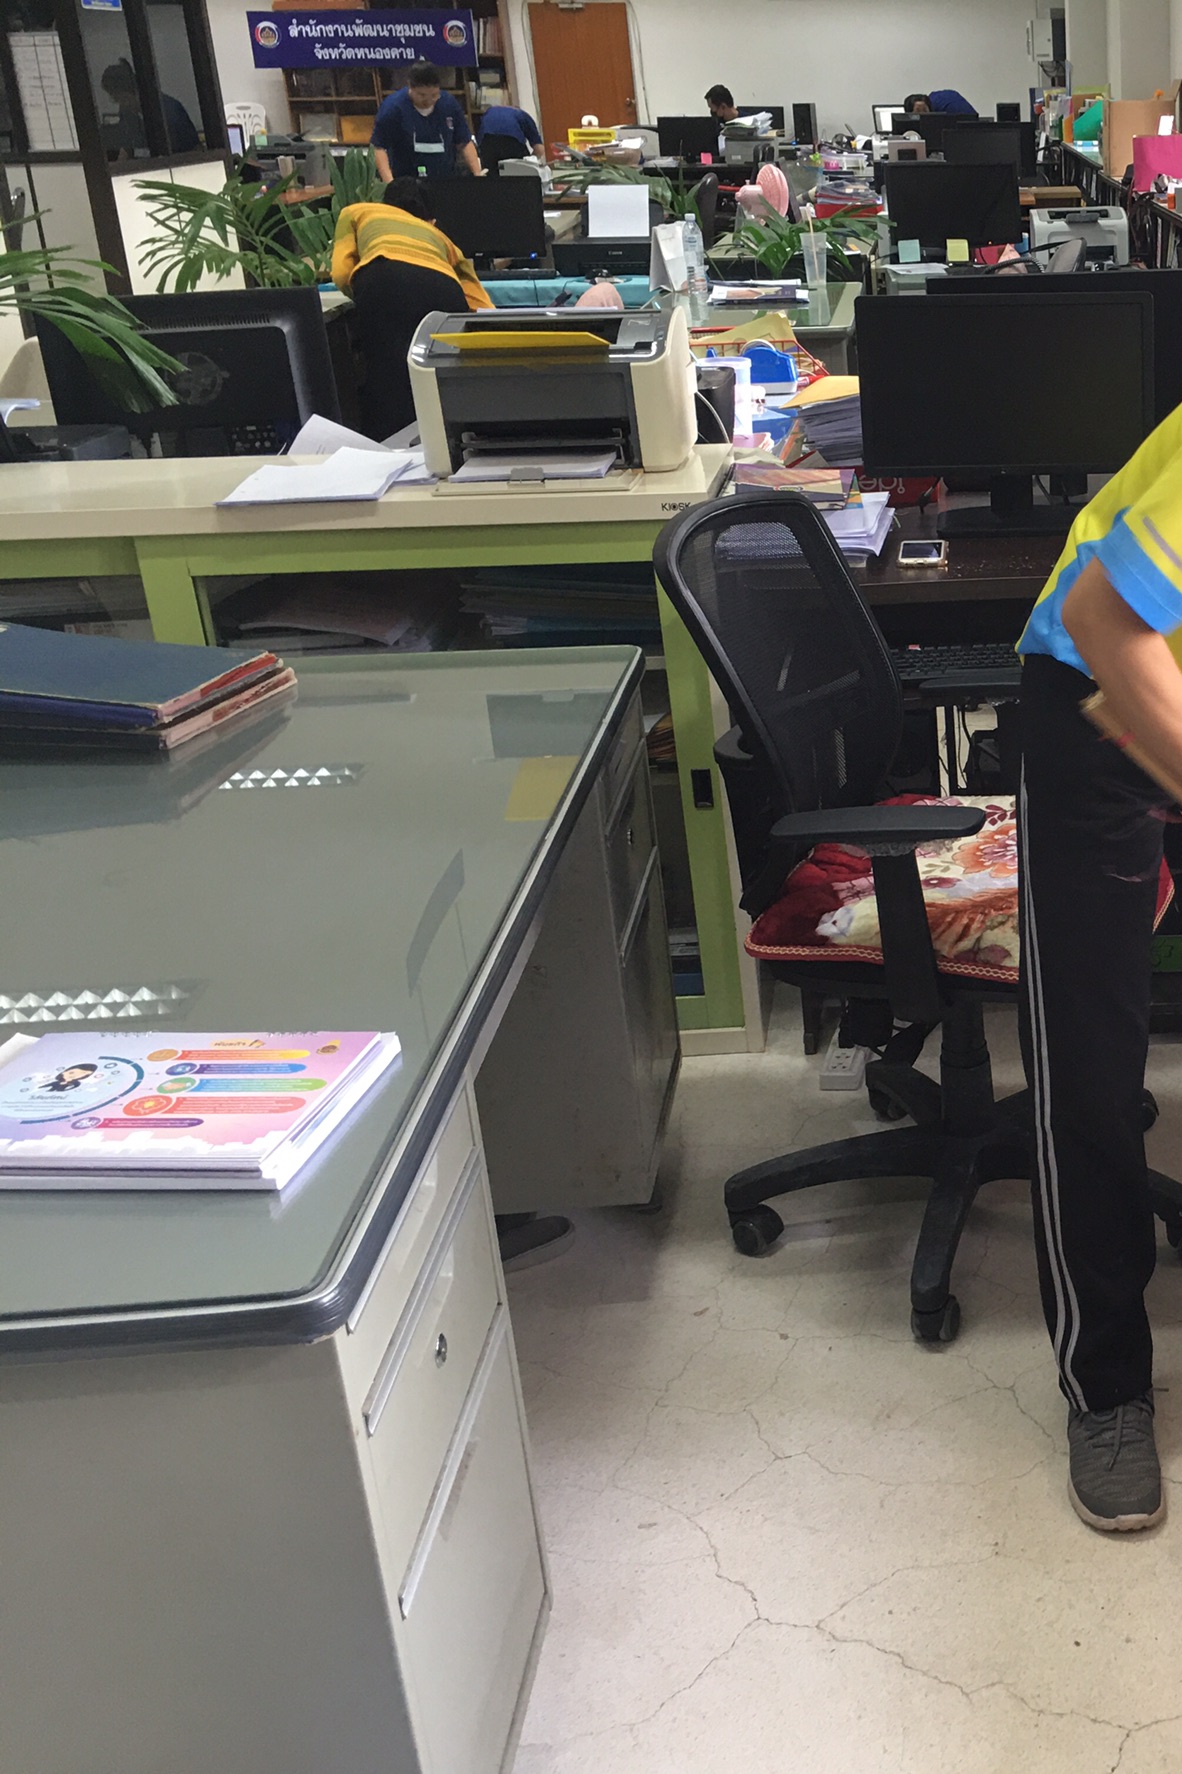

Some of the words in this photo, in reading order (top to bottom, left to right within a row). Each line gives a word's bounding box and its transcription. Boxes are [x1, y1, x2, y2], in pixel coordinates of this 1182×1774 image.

[288, 18, 435, 44] สำนักงานพัฒนาชุมชน
[314, 43, 415, 60] จังหวัดหนองคาย
[858, 475, 906, 495] ide
